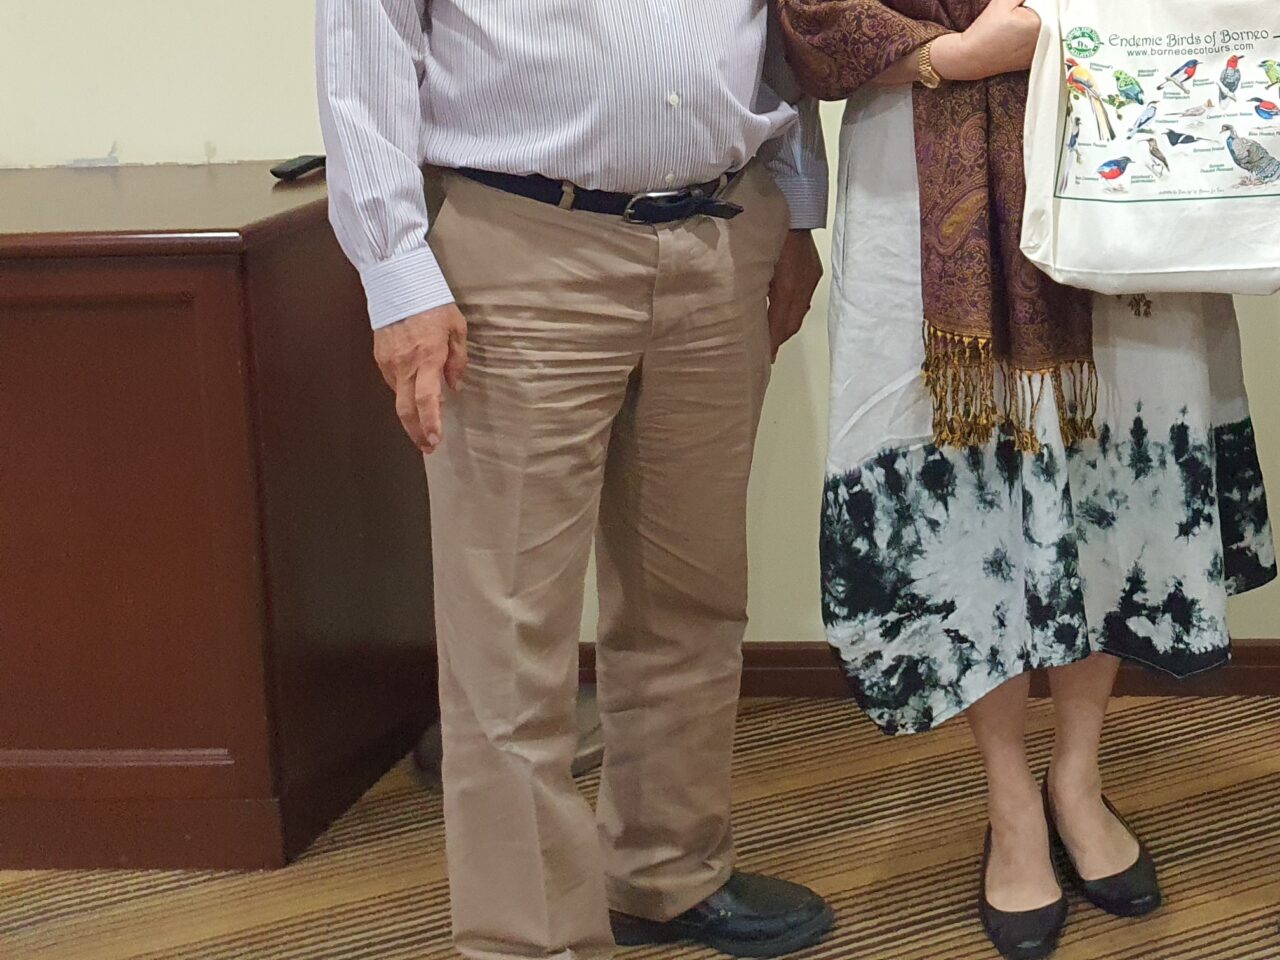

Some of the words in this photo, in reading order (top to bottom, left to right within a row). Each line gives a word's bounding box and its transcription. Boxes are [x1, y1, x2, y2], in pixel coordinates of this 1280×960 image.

[1108, 33, 1163, 48] Endemic
[1166, 32, 1202, 48] Birds
[1204, 30, 1217, 47] of
[1220, 28, 1269, 44] Borneo
[1127, 42, 1254, 57] www.borneoecotours.com
